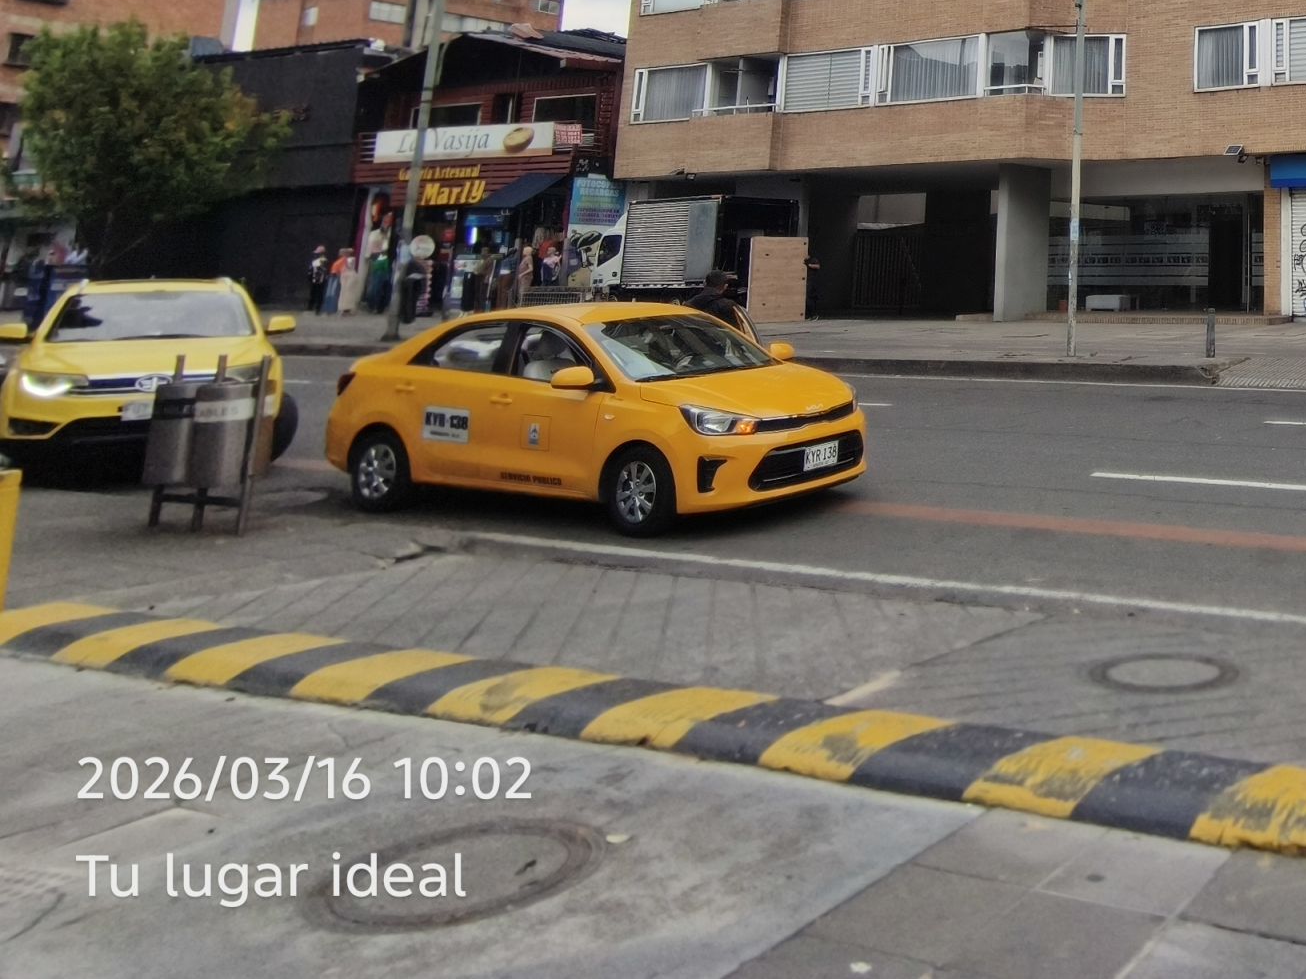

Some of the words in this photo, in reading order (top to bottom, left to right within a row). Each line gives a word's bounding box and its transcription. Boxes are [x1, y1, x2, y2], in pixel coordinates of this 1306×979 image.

[431, 128, 490, 157] Vasija
[435, 164, 481, 179] Artesanal
[420, 180, 486, 206] Marly
[806, 449, 821, 464] KYR
[823, 445, 837, 460] 138
